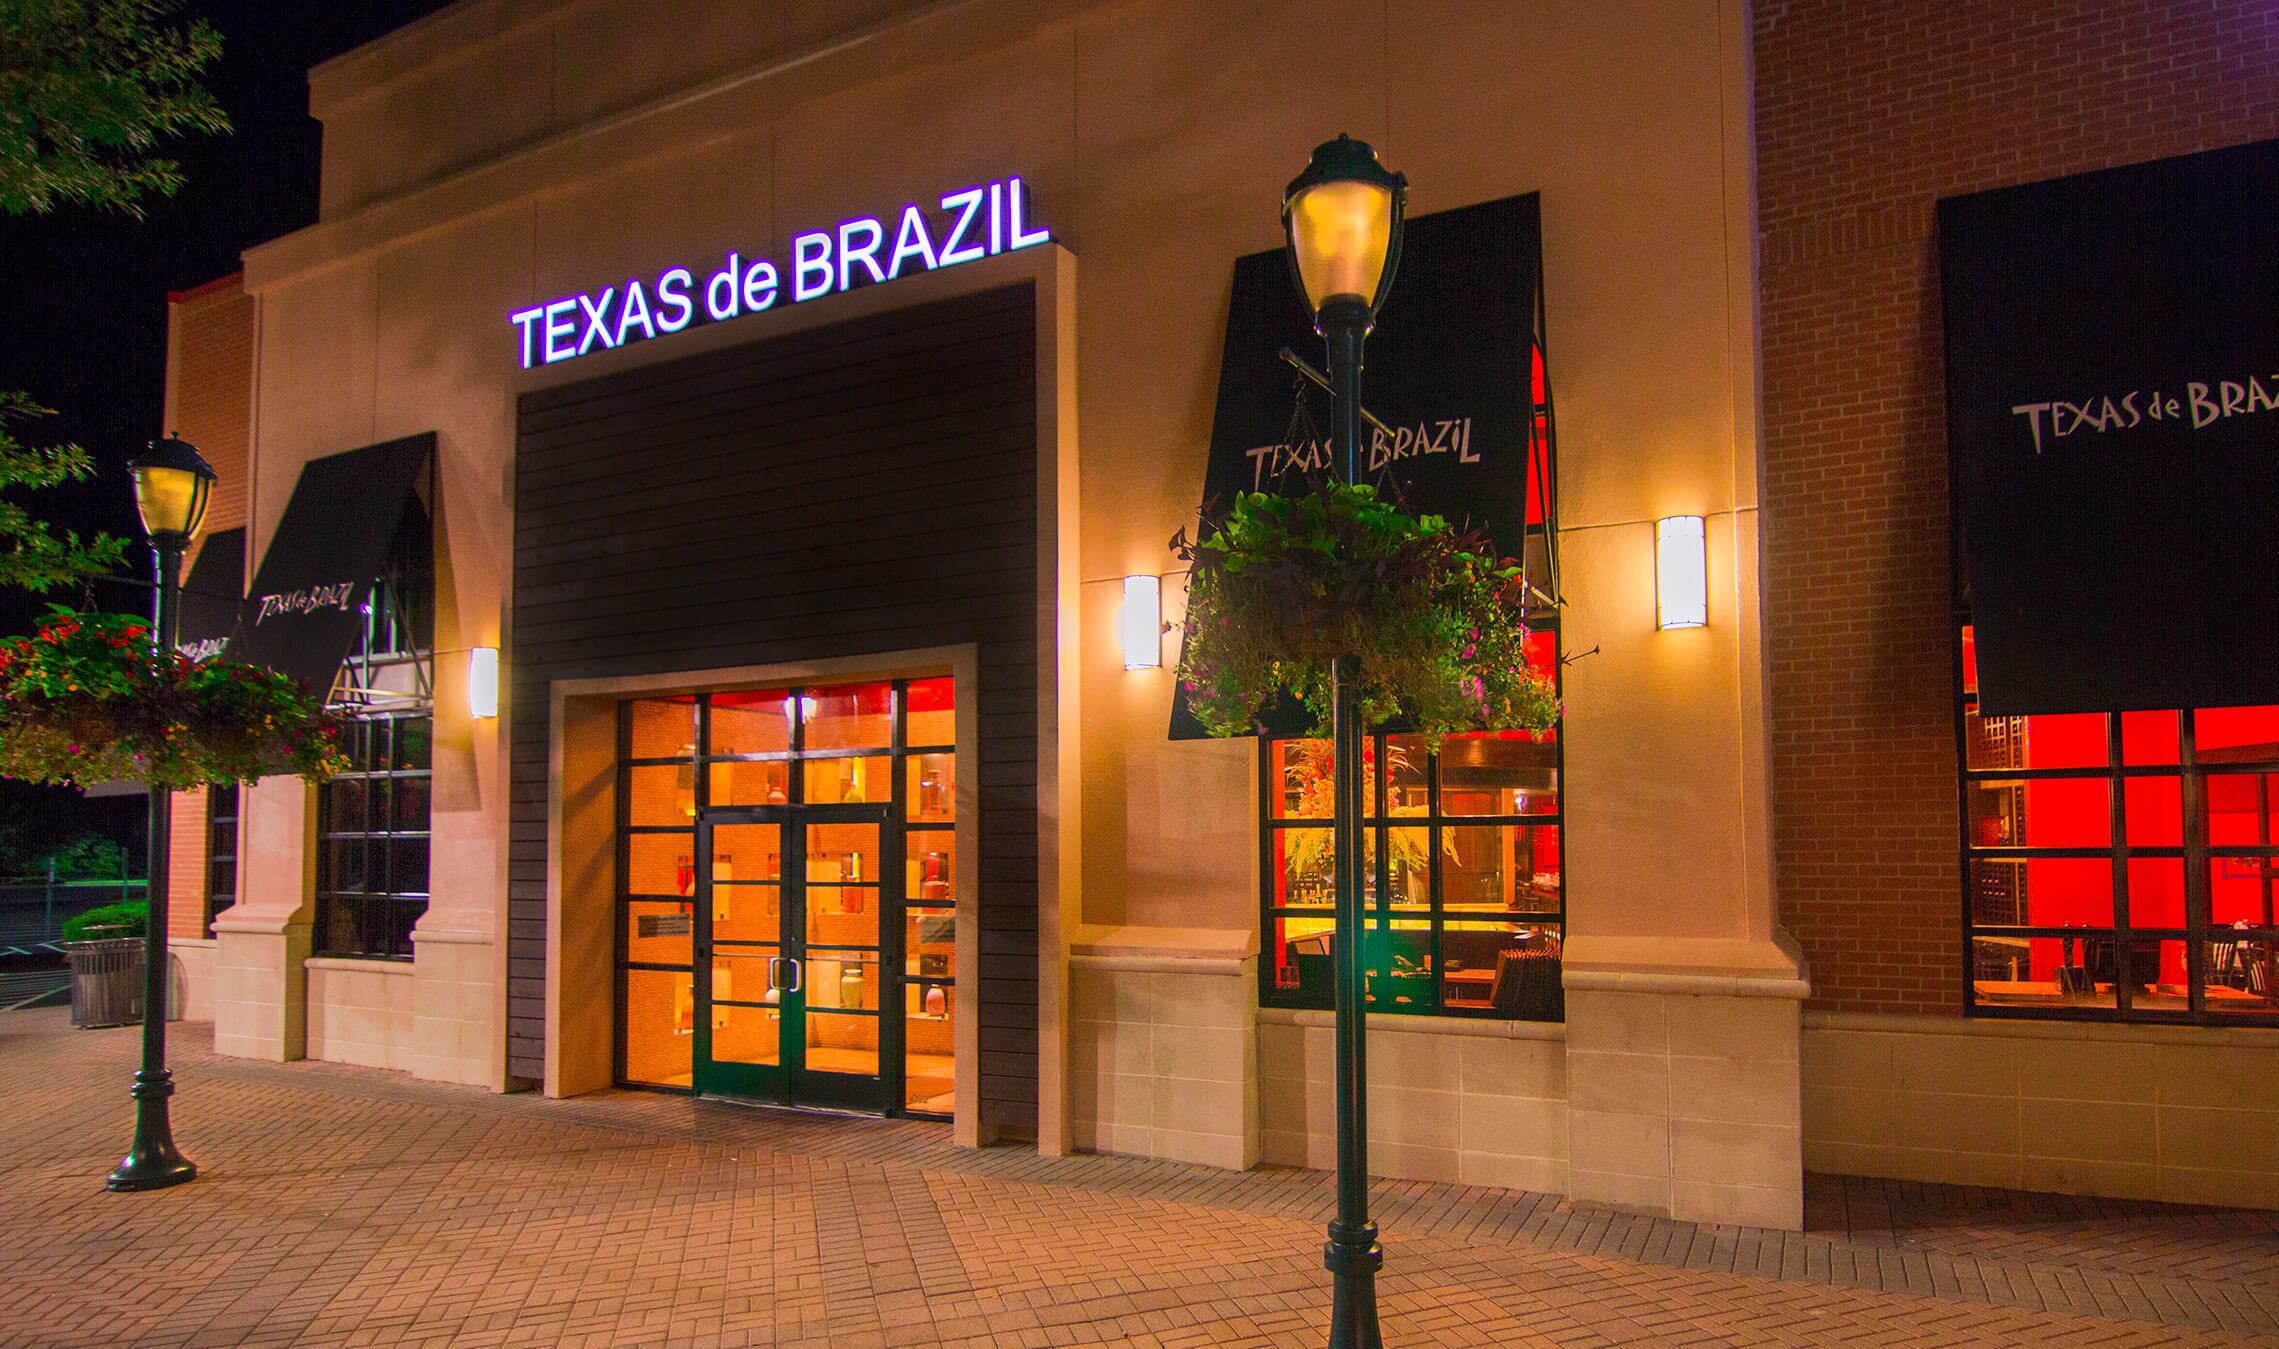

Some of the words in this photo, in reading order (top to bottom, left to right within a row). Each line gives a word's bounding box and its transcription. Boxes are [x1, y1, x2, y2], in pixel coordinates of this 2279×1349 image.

[510, 266, 693, 370] TEXAS
[704, 250, 779, 321] de
[791, 174, 1050, 303] BRAZIL
[1246, 438, 1333, 492] TEXAS
[1369, 417, 1480, 472] BRAZIL
[2012, 390, 2141, 455] TEXAS
[2149, 391, 2180, 421] de
[2187, 374, 2279, 430] BRA
